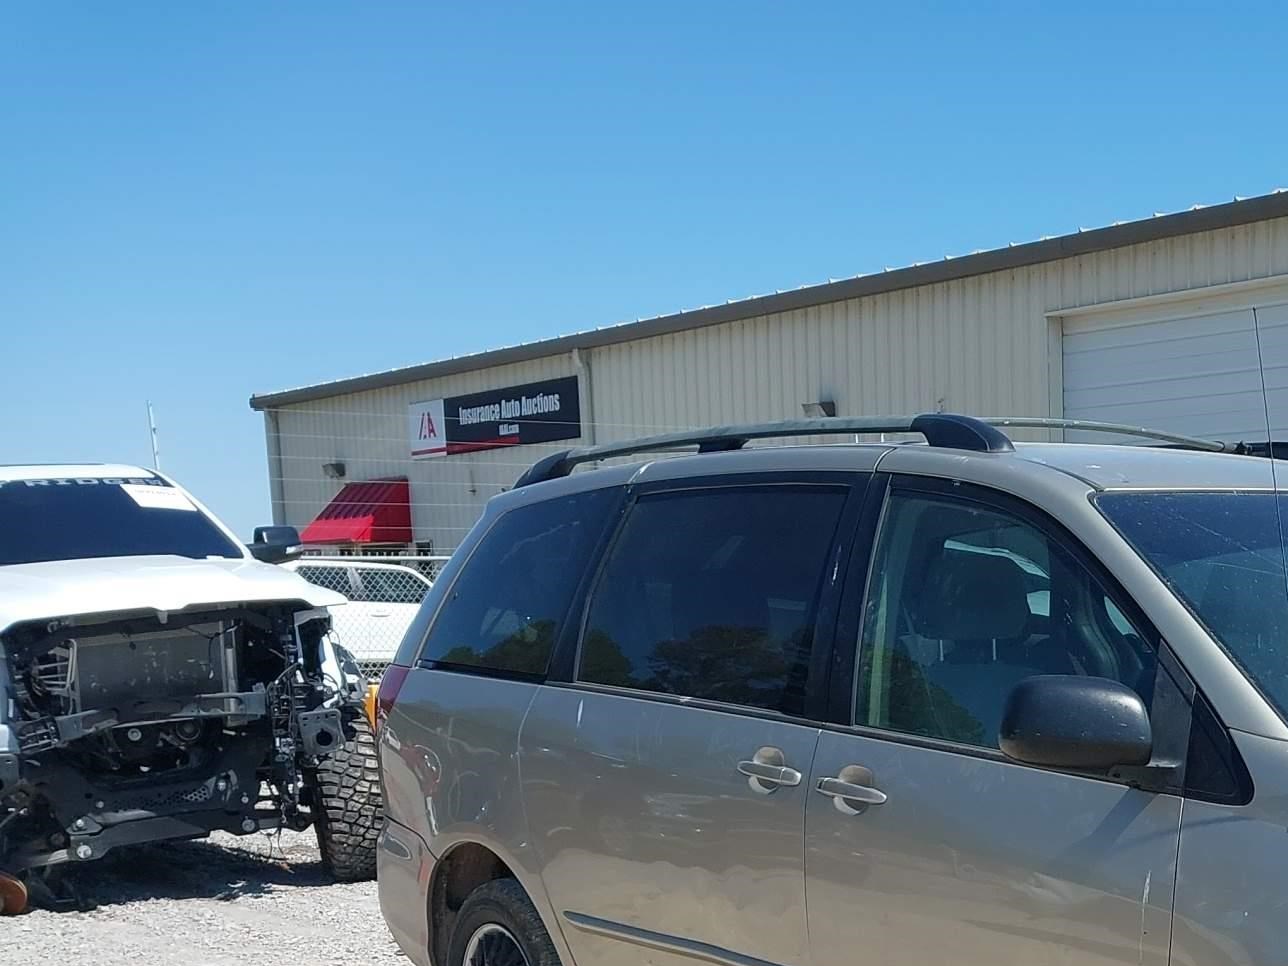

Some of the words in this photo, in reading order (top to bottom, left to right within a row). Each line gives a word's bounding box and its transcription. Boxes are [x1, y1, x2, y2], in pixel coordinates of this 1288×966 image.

[459, 403, 500, 425] Insurance
[501, 399, 520, 419] Auto
[521, 393, 560, 416] Auctions
